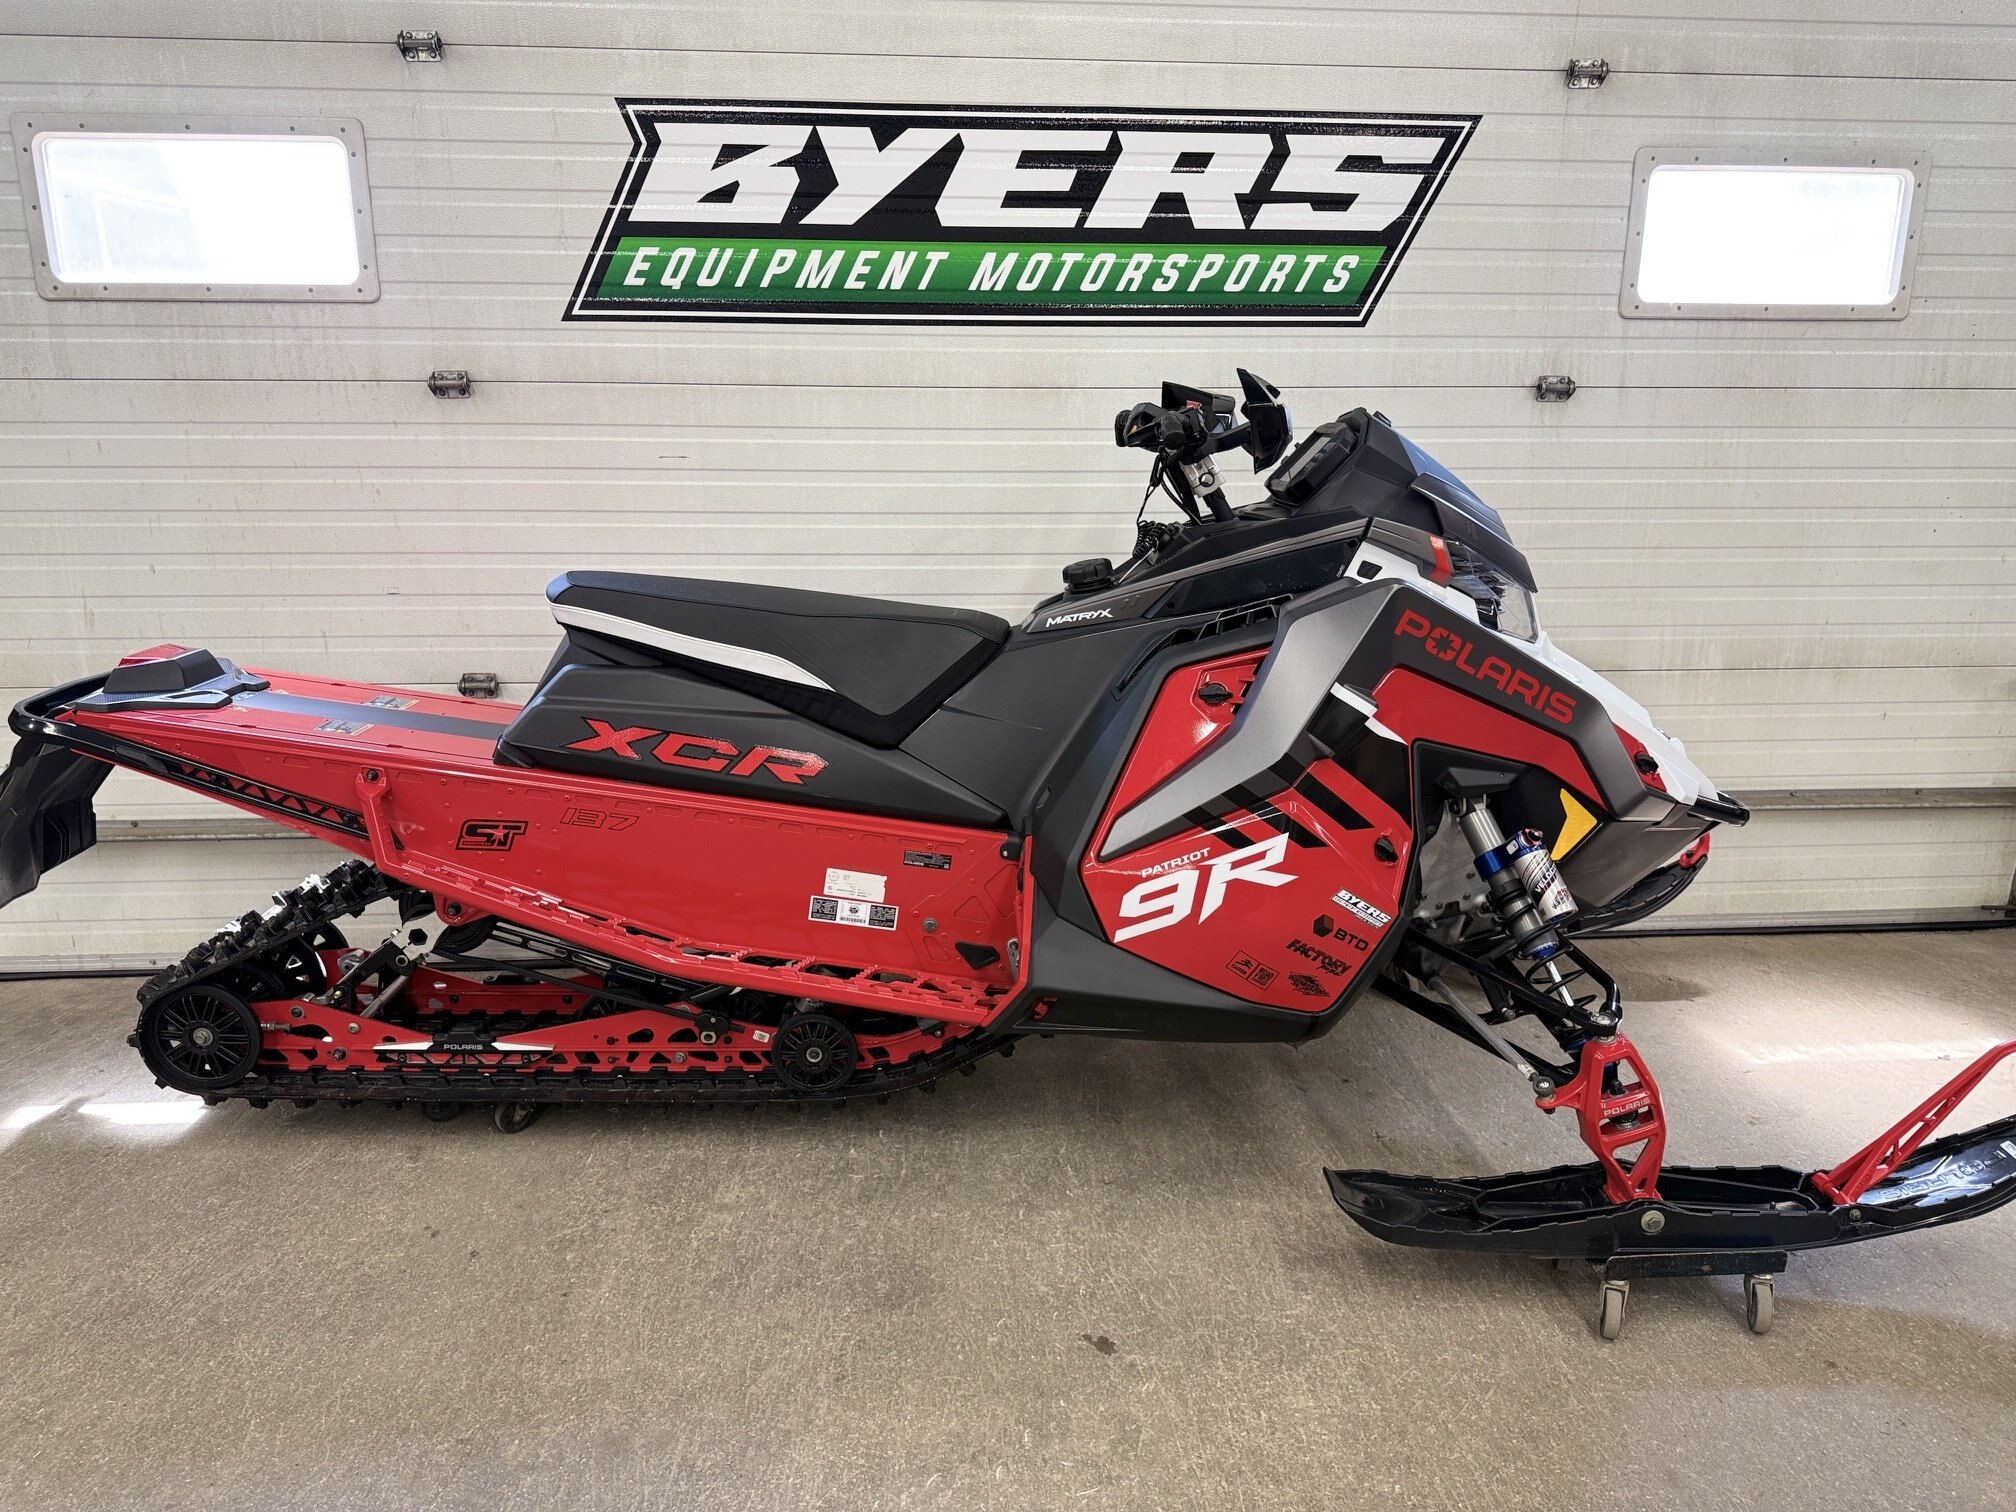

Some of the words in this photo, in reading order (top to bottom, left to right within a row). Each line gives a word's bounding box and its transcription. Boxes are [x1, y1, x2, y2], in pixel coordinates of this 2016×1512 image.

[628, 122, 1446, 231] BYERS
[623, 247, 949, 290] EQUIPMENT
[968, 252, 1360, 293] MOTORSPORTS
[1046, 608, 1113, 628] MATRYX
[1394, 608, 1577, 724] POLARIS
[560, 717, 829, 785] XCR
[560, 807, 639, 831] 137
[1141, 847, 1211, 878] PATRIOT
[1535, 863, 1557, 893] VELOCI
[1114, 832, 1299, 943] 9R
[1336, 889, 1392, 923] BYERS
[1333, 927, 1369, 951] BTD
[1285, 938, 1352, 976] FACTORY
[1603, 1096, 1651, 1117] POLARIS
